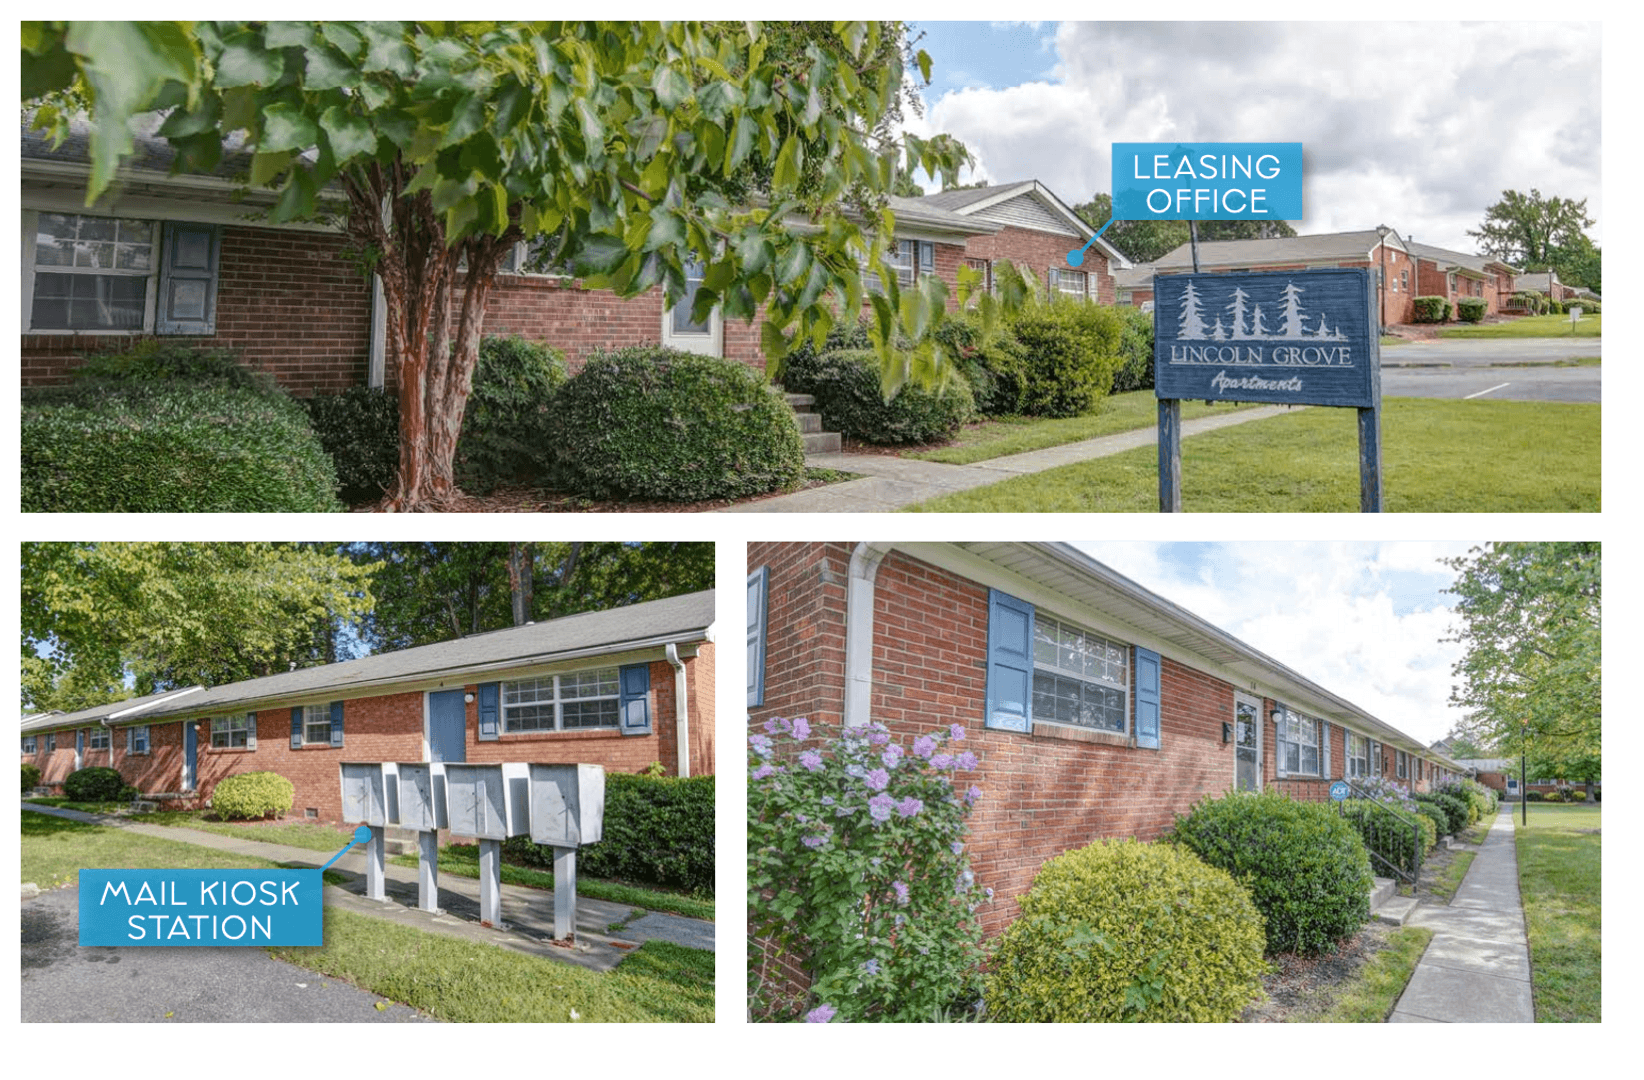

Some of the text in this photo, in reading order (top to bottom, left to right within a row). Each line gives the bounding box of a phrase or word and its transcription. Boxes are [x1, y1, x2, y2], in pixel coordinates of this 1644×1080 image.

[1170, 345, 1352, 365] LINCOLN GROVE
[1211, 370, 1302, 394] Apartments
